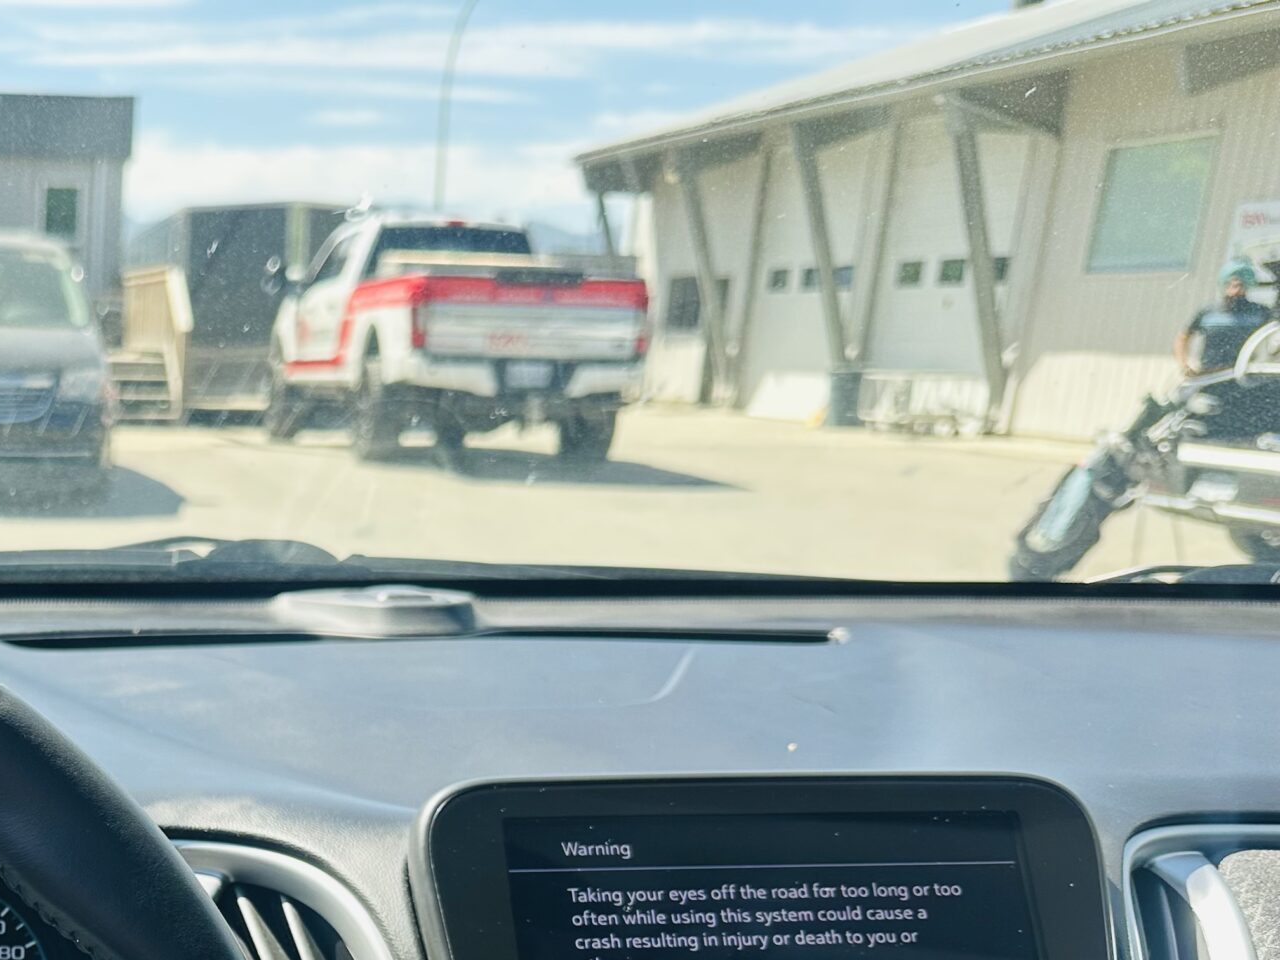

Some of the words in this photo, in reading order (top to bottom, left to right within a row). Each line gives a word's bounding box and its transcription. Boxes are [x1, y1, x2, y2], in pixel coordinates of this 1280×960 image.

[561, 841, 631, 859] Warning
[567, 887, 622, 905] Taking
[627, 887, 664, 904] your
[669, 887, 706, 903] eyes
[711, 884, 737, 900] off
[740, 884, 767, 900] the
[771, 883, 809, 899] road
[813, 883, 837, 898] for
[840, 884, 868, 898] too
[872, 882, 909, 901] long
[912, 883, 930, 897] or
[933, 882, 961, 896] too
[572, 910, 619, 926] often
[622, 908, 667, 926] while
[671, 908, 716, 927] using
[720, 907, 751, 924] this
[755, 908, 814, 926] system
[817, 905, 862, 921] could
[866, 907, 913, 921] cause
[916, 908, 928, 920] a
[575, 933, 621, 950] crash
[625, 930, 699, 952] resulting
[702, 930, 718, 947] in
[722, 930, 768, 950] injury
[772, 932, 790, 946] or
[795, 929, 843, 945] death
[845, 930, 863, 944] to
[866, 930, 896, 946] you
[900, 930, 917, 942] or
